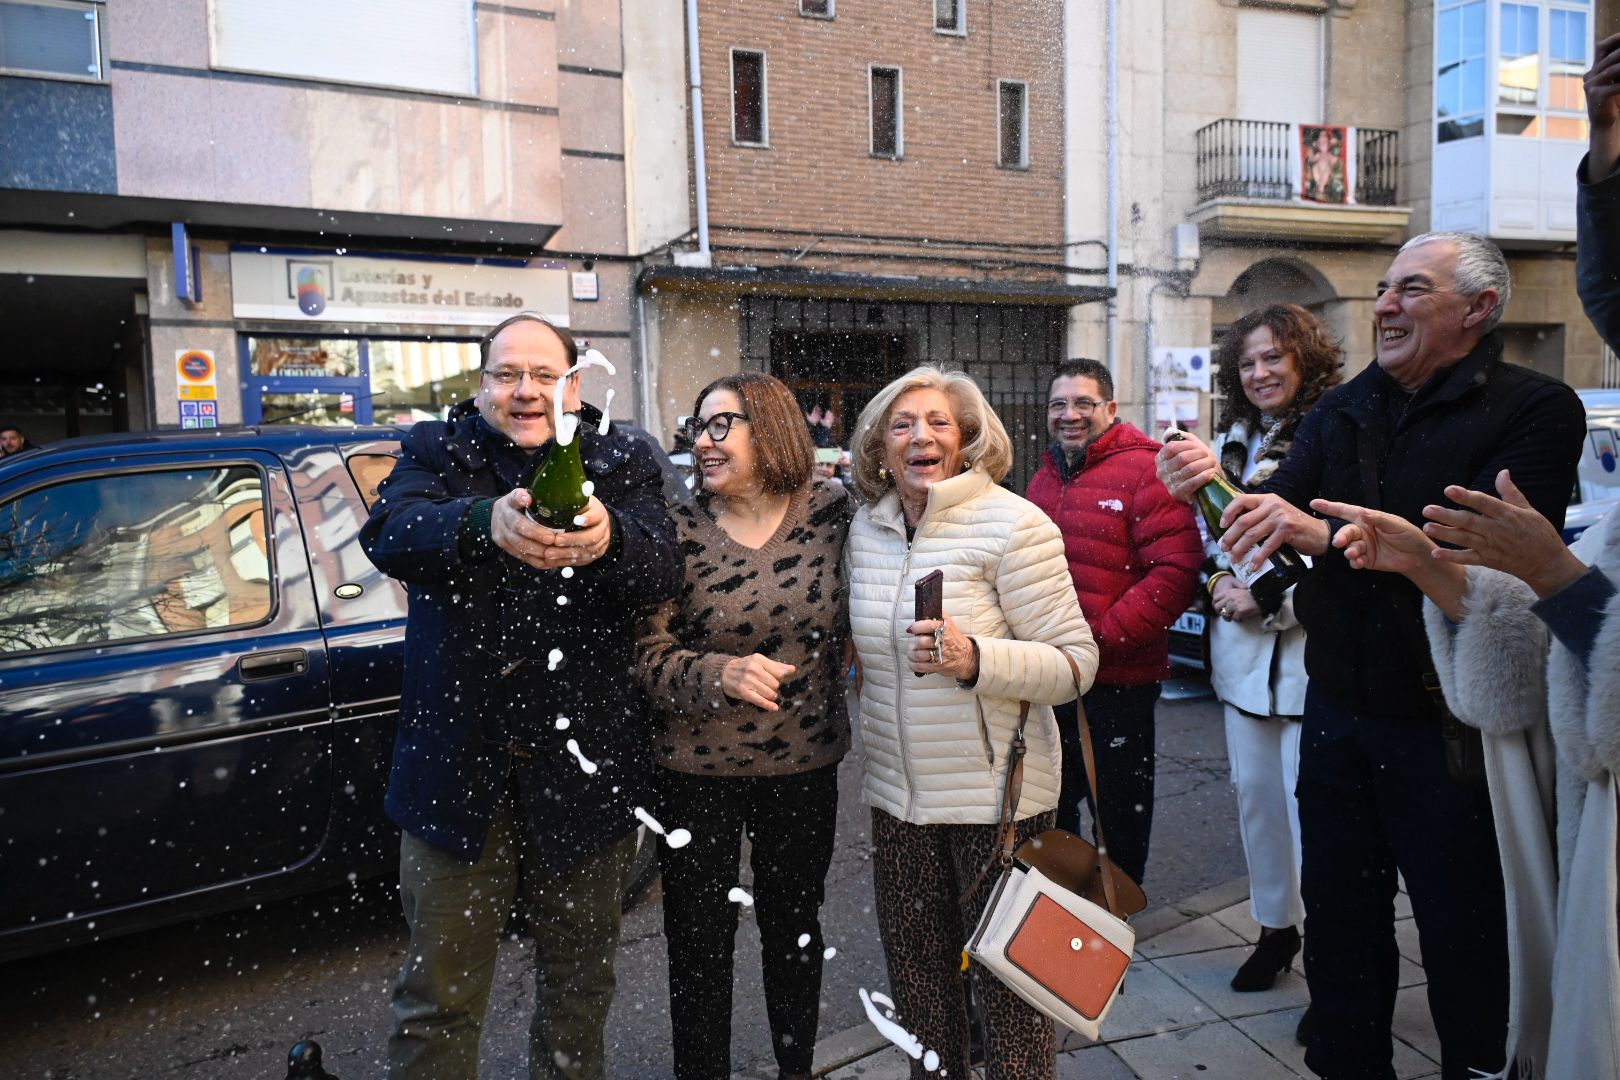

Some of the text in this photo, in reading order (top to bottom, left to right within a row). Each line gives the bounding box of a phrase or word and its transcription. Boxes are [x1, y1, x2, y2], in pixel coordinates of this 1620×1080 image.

[339, 266, 433, 290] Loterías y
[341, 286, 524, 308] Apuestas del Estado
